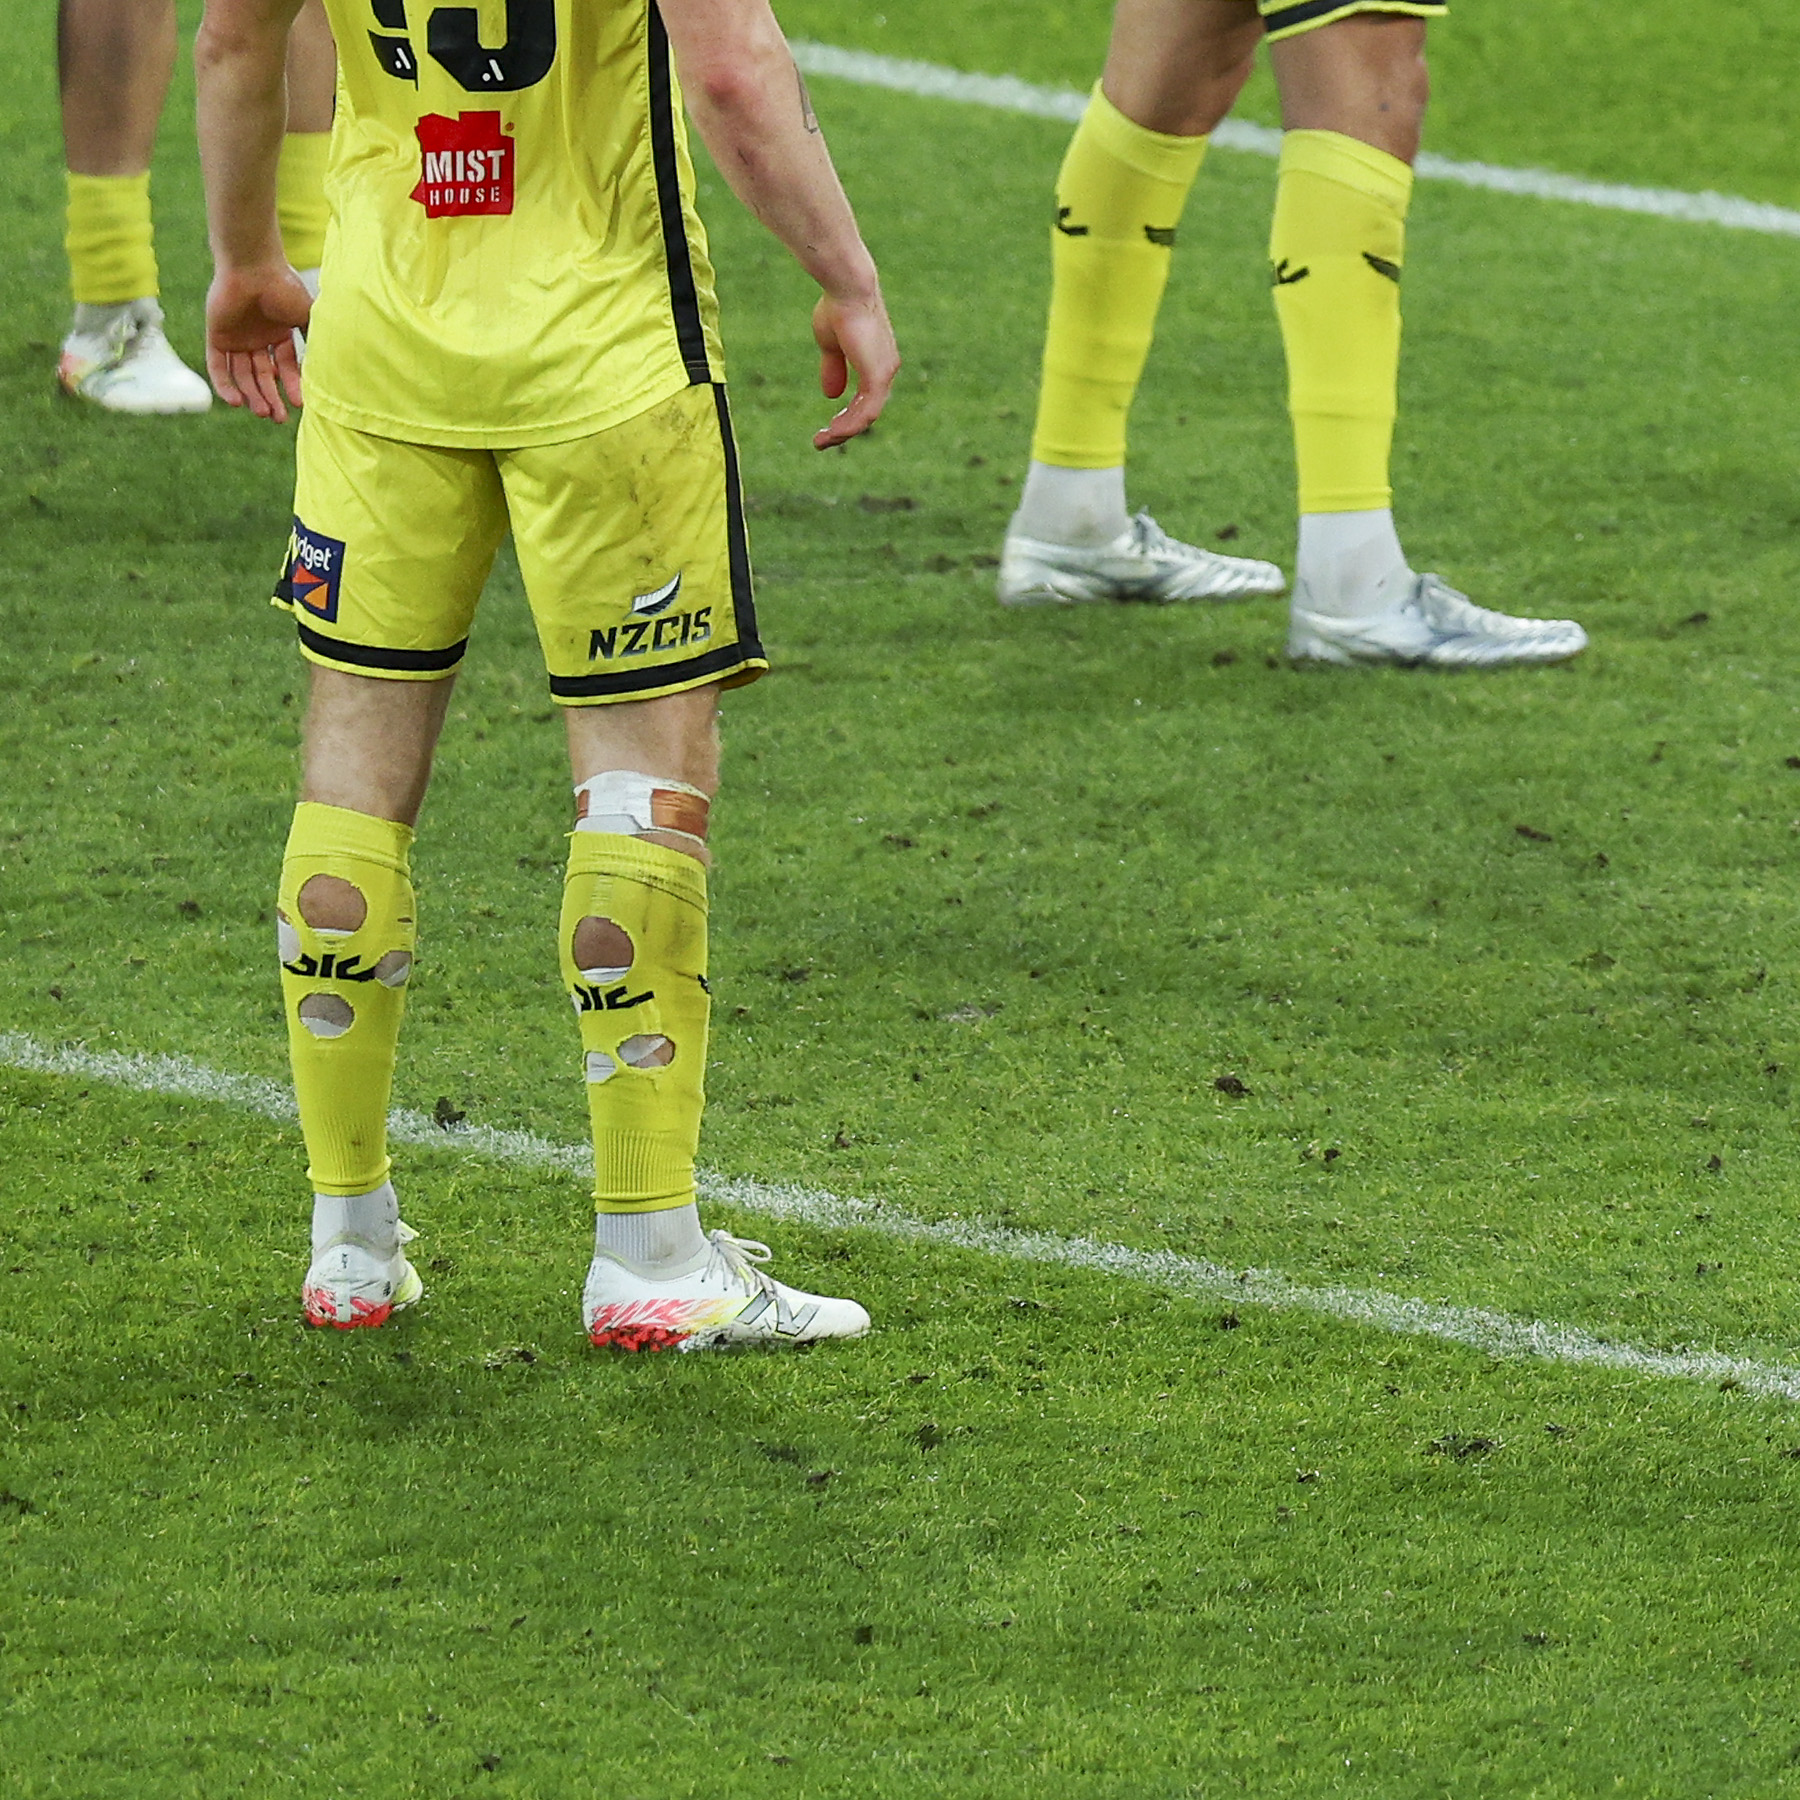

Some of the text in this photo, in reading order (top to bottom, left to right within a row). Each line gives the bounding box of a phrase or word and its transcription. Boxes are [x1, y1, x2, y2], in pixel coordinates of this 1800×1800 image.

[424, 148, 506, 184] MIST
[429, 185, 501, 207] HOUSE
[297, 535, 332, 571] dget
[588, 606, 711, 662] NZCIS
